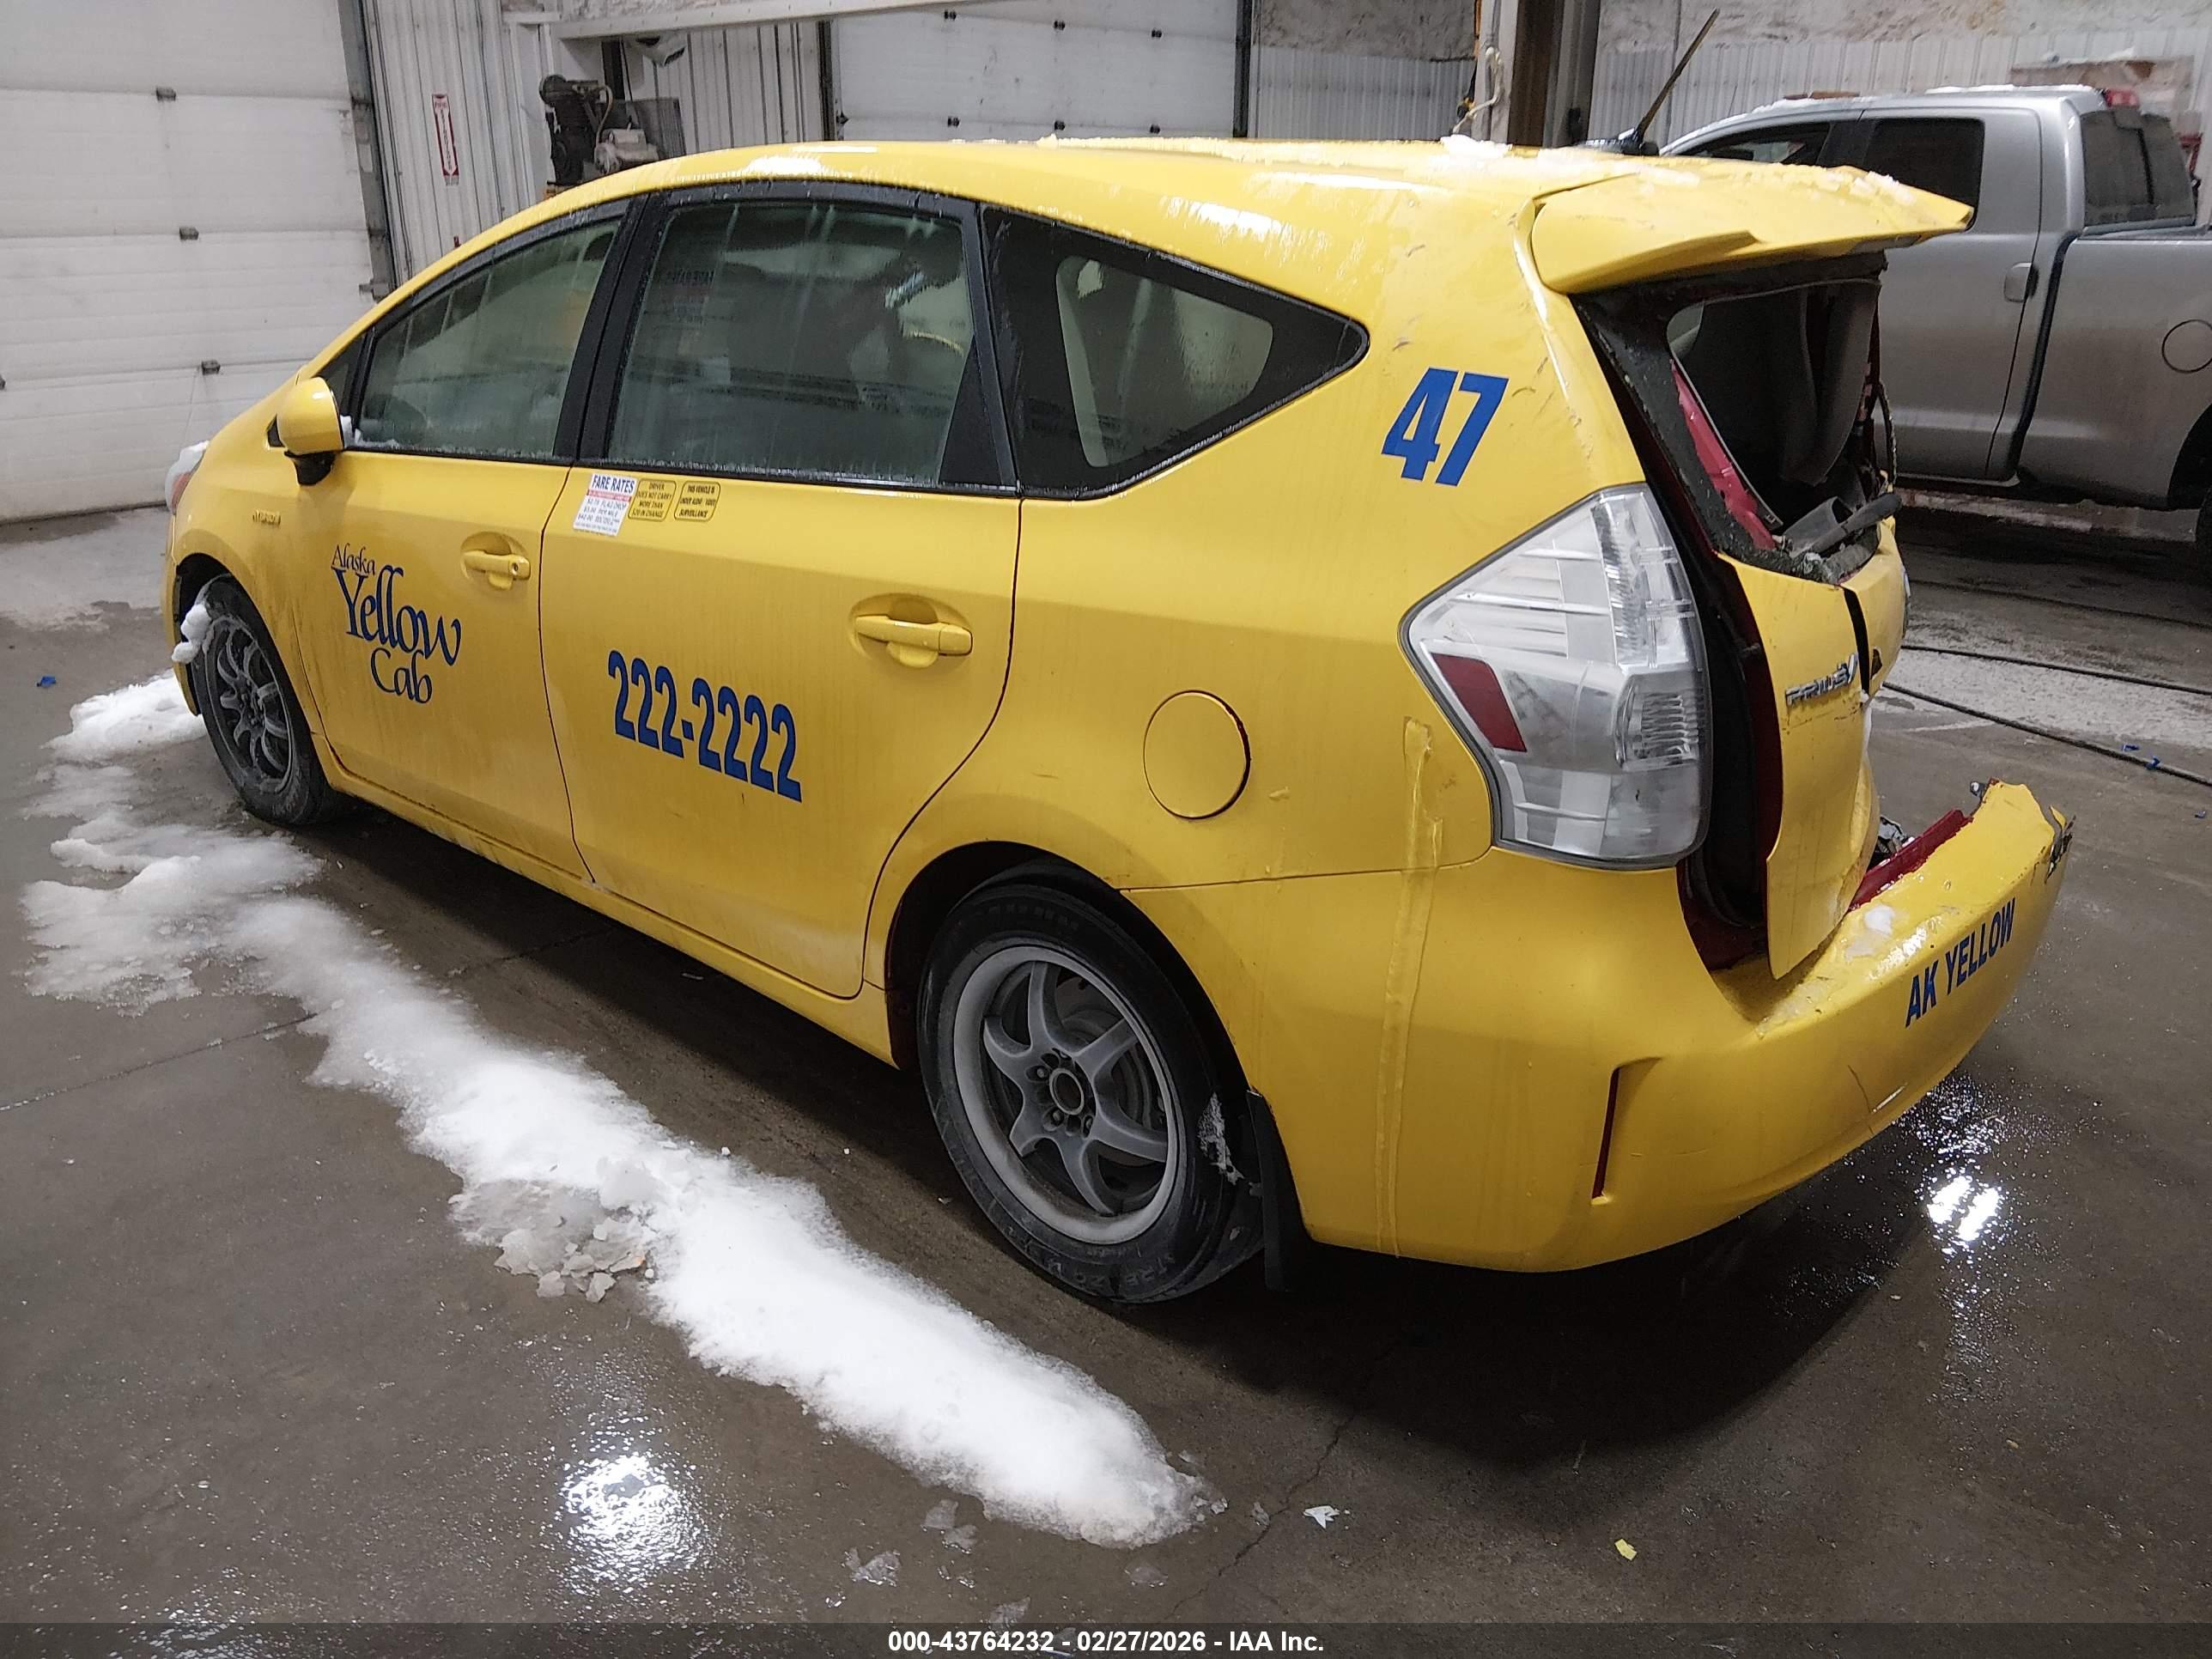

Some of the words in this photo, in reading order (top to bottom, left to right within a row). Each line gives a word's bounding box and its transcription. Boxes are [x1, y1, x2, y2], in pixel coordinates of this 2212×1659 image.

[1381, 368, 1509, 487] 47
[592, 475, 611, 489] FARE
[611, 477, 635, 494] RATES
[331, 543, 375, 575] Alaska
[331, 565, 461, 666] Yellow
[370, 647, 432, 704] Cab
[608, 650, 802, 803] 222-2222
[1905, 959, 1939, 1028] AK
[1945, 897, 2015, 995] YELLOW
